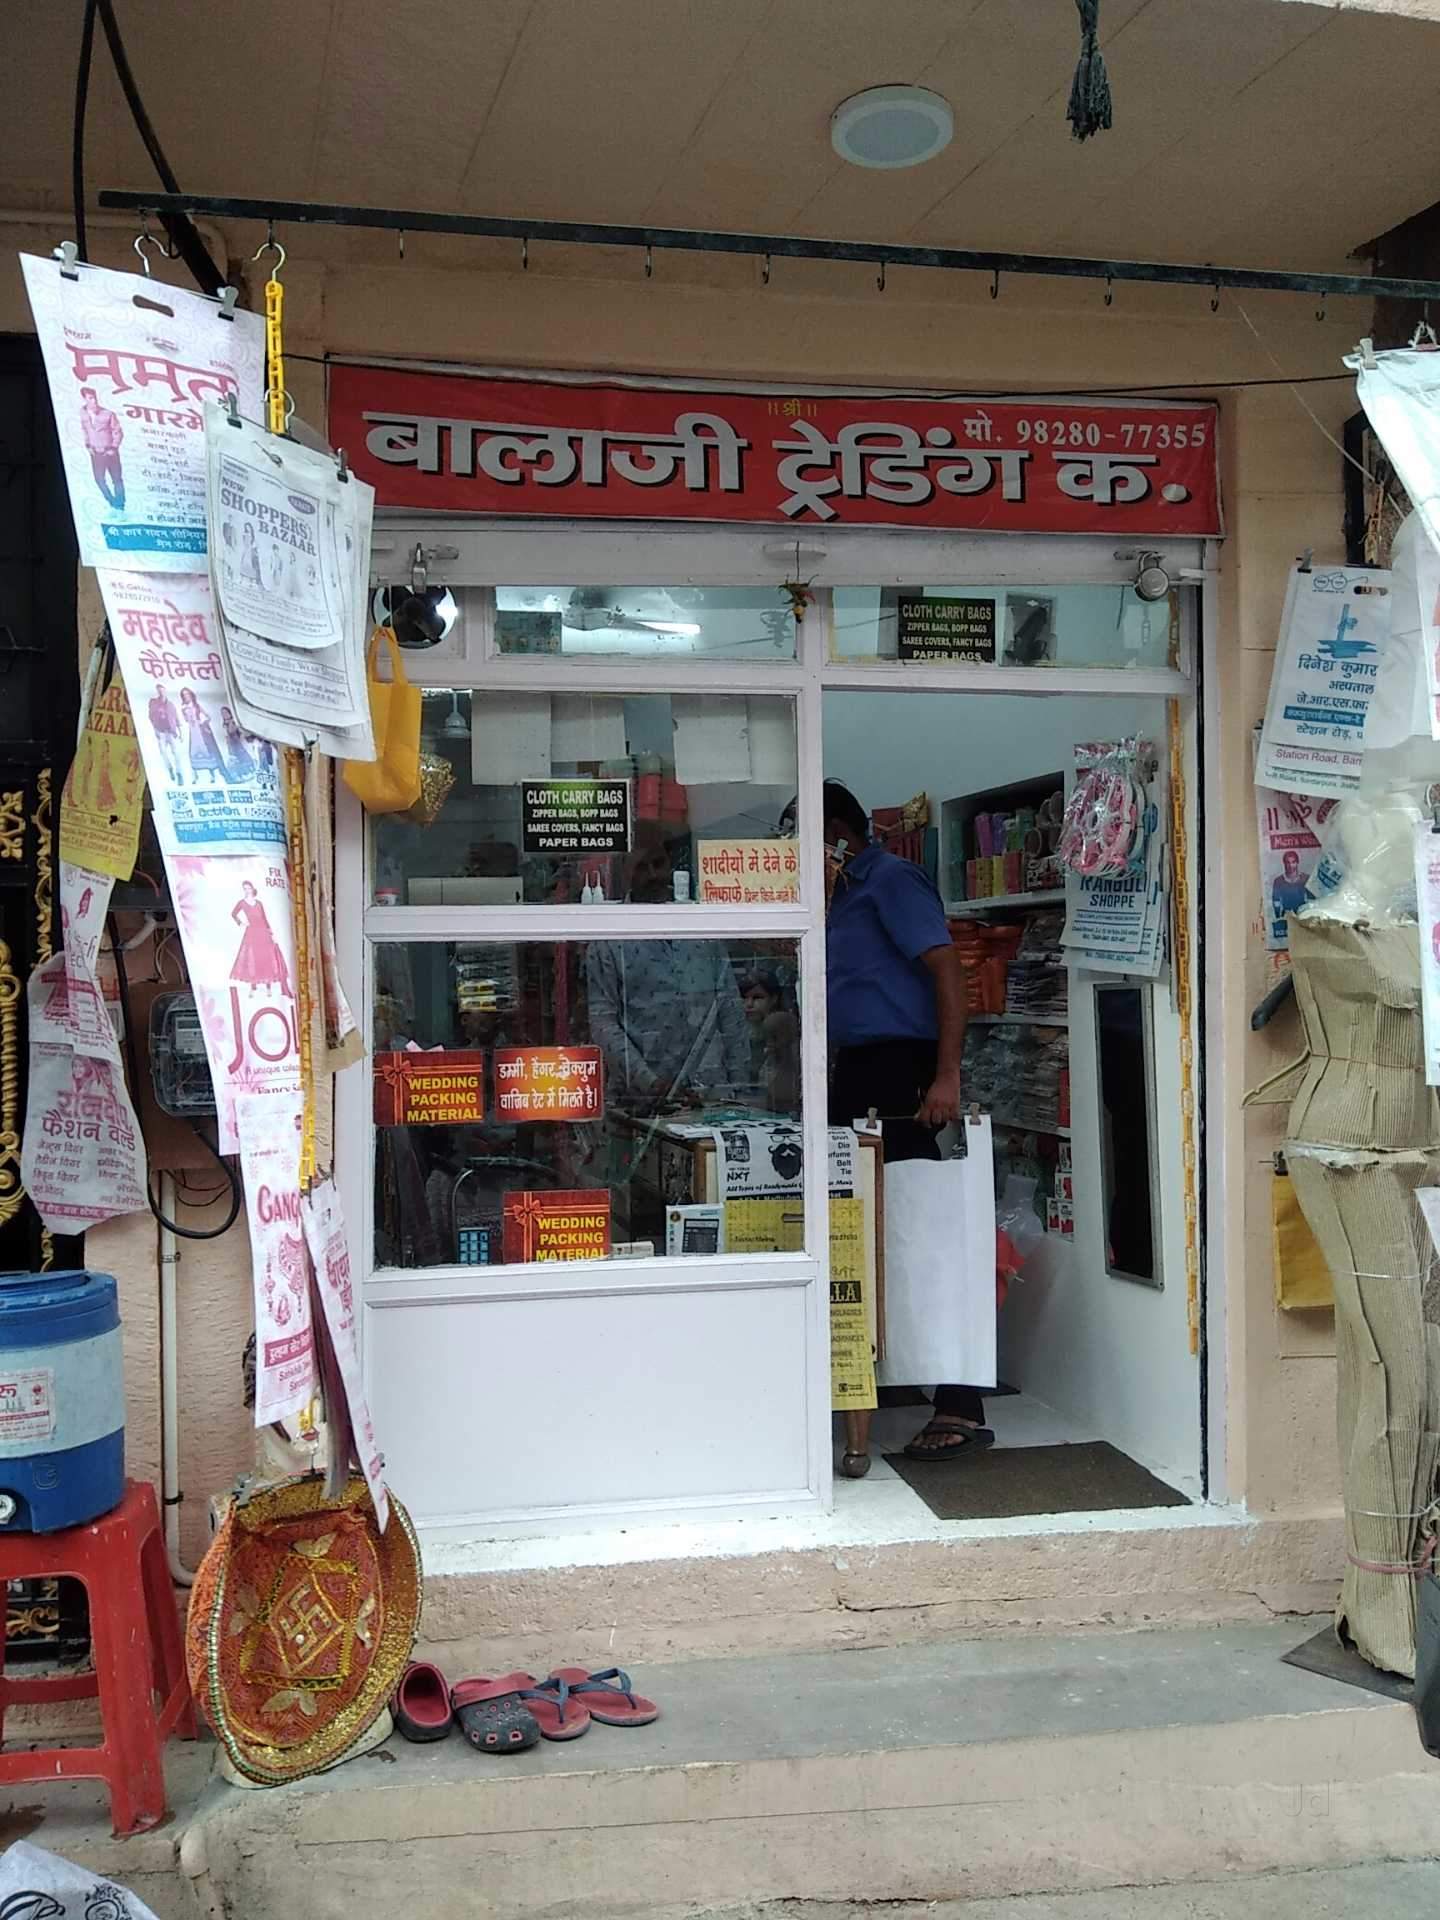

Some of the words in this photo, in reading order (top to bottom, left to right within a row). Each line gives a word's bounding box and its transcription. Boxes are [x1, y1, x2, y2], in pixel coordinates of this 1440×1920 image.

[963, 410, 1003, 443] मो.
[1016, 419, 1206, 449] 98280-77355
[361, 410, 749, 491] बालाजी
[771, 418, 1030, 521] ट्रेडिंग
[1052, 450, 1189, 504] क.
[221, 477, 246, 493] NEW
[220, 488, 309, 542] SHOPPERS
[258, 520, 317, 557] BAZAAR
[902, 604, 932, 618] CLOTH
[934, 605, 965, 620] CARRY
[967, 606, 992, 621] BAGS
[118, 599, 212, 648] महादेव
[906, 622, 930, 632] ZIPPER
[931, 623, 951, 633] BAGS,
[969, 624, 987, 633] BAGS
[902, 636, 923, 645] SAREE
[924, 636, 951, 647] COVERS,
[952, 637, 973, 647] FANCY
[974, 638, 992, 648] BAGS
[912, 650, 949, 660] PAPER
[951, 651, 982, 661] BAGS
[138, 649, 222, 681] फैमिली
[1296, 653, 1336, 672] दिनेश
[1340, 661, 1378, 678] कुमार
[1328, 680, 1376, 695] अस्पताल
[1275, 748, 1310, 761] Station
[526, 789, 560, 805] CLOTH
[561, 789, 595, 805] CARRY
[597, 789, 624, 805] BAGS
[532, 808, 557, 818] ZIPPER
[558, 808, 579, 819] BAGS,
[580, 808, 599, 818] BOPP
[599, 808, 619, 818] BAGS
[527, 823, 550, 833] SAREE
[551, 823, 581, 834] COVERS,
[581, 823, 605, 833] FANCY
[605, 823, 624, 833] BAGS
[539, 837, 578, 848] PAPER
[580, 837, 614, 848] BAGS
[702, 848, 744, 875] शादीयों
[747, 848, 760, 873] में
[763, 848, 780, 873] देने
[783, 847, 797, 873] के
[268, 867, 282, 878] FIX
[265, 877, 286, 889] RATE
[1089, 894, 1135, 909] SHOPPE
[408, 1076, 479, 1091] WEDDING
[410, 1091, 478, 1106] PACKING
[499, 1087, 530, 1110] वाजिब
[531, 1088, 545, 1110] रेट
[546, 1085, 556, 1108] में
[558, 1086, 584, 1108] मिलते
[406, 1107, 482, 1122] MATERIAL
[41, 1108, 102, 1142] फैशन
[836, 1159, 852, 1167] Belt
[726, 1172, 750, 1183] NXT
[537, 1216, 606, 1230] WEDDING
[539, 1231, 605, 1246] PACKING
[535, 1249, 606, 1263] MATERIAL
